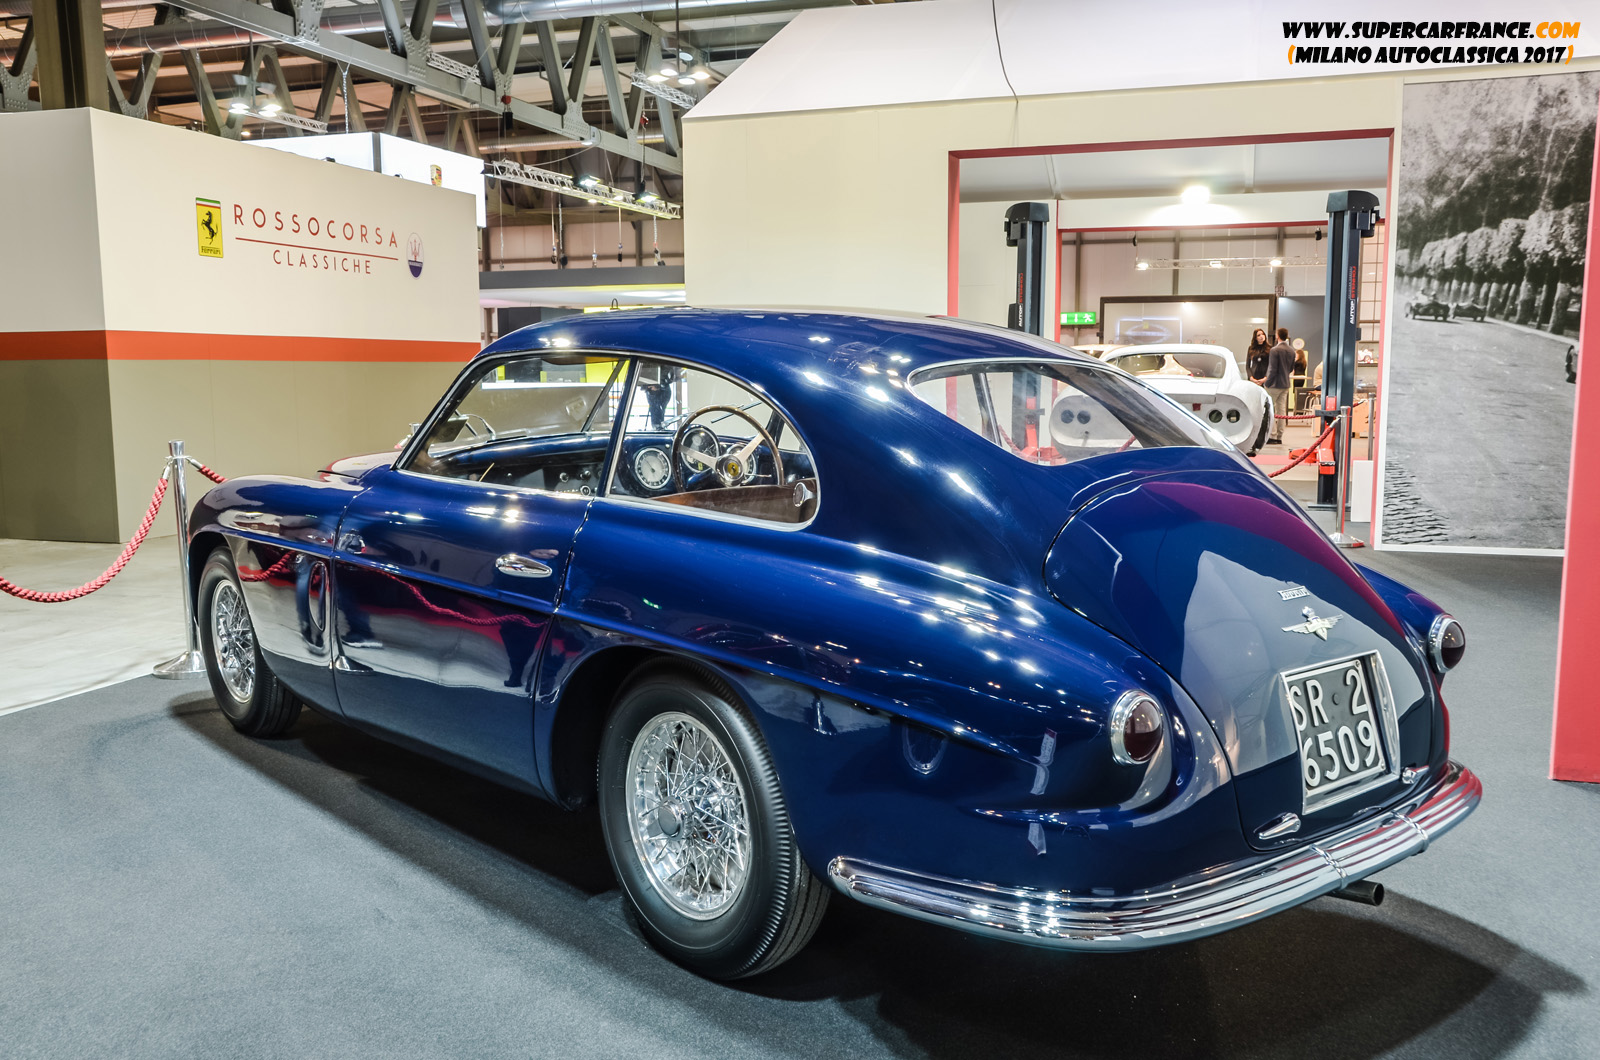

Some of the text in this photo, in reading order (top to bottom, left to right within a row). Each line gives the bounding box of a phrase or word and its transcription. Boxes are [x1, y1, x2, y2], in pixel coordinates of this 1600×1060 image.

[233, 203, 398, 248] ROSSOCORSA
[201, 246, 221, 255] Ferrari
[273, 249, 371, 275] CLASSICHE
[1289, 669, 1369, 731] SR 2
[1303, 719, 1377, 787] 6509
